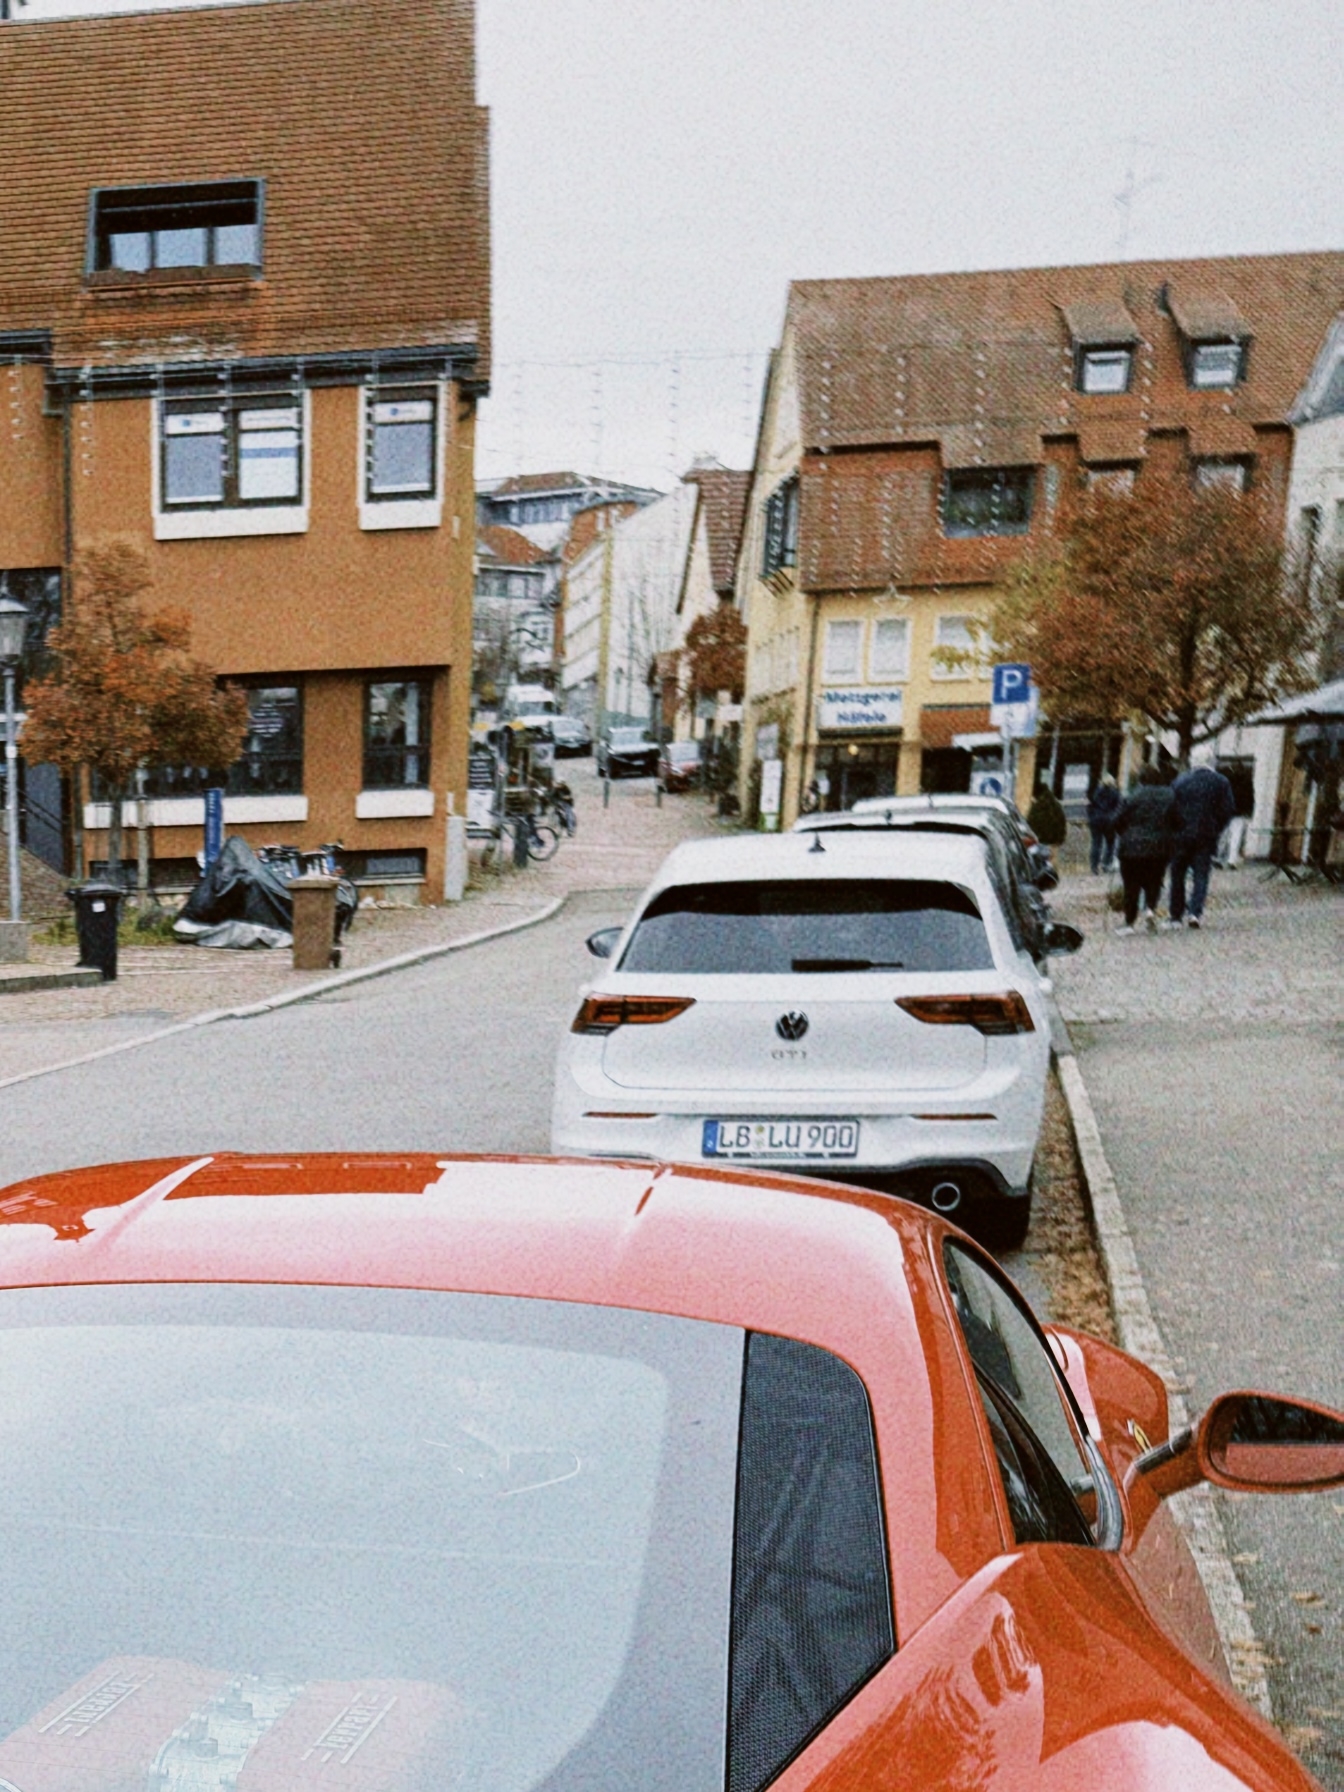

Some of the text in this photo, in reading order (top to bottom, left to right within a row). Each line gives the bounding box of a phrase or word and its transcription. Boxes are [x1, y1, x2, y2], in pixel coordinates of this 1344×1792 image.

[1001, 669, 1023, 700] P
[719, 1124, 854, 1149] LB LU 900
